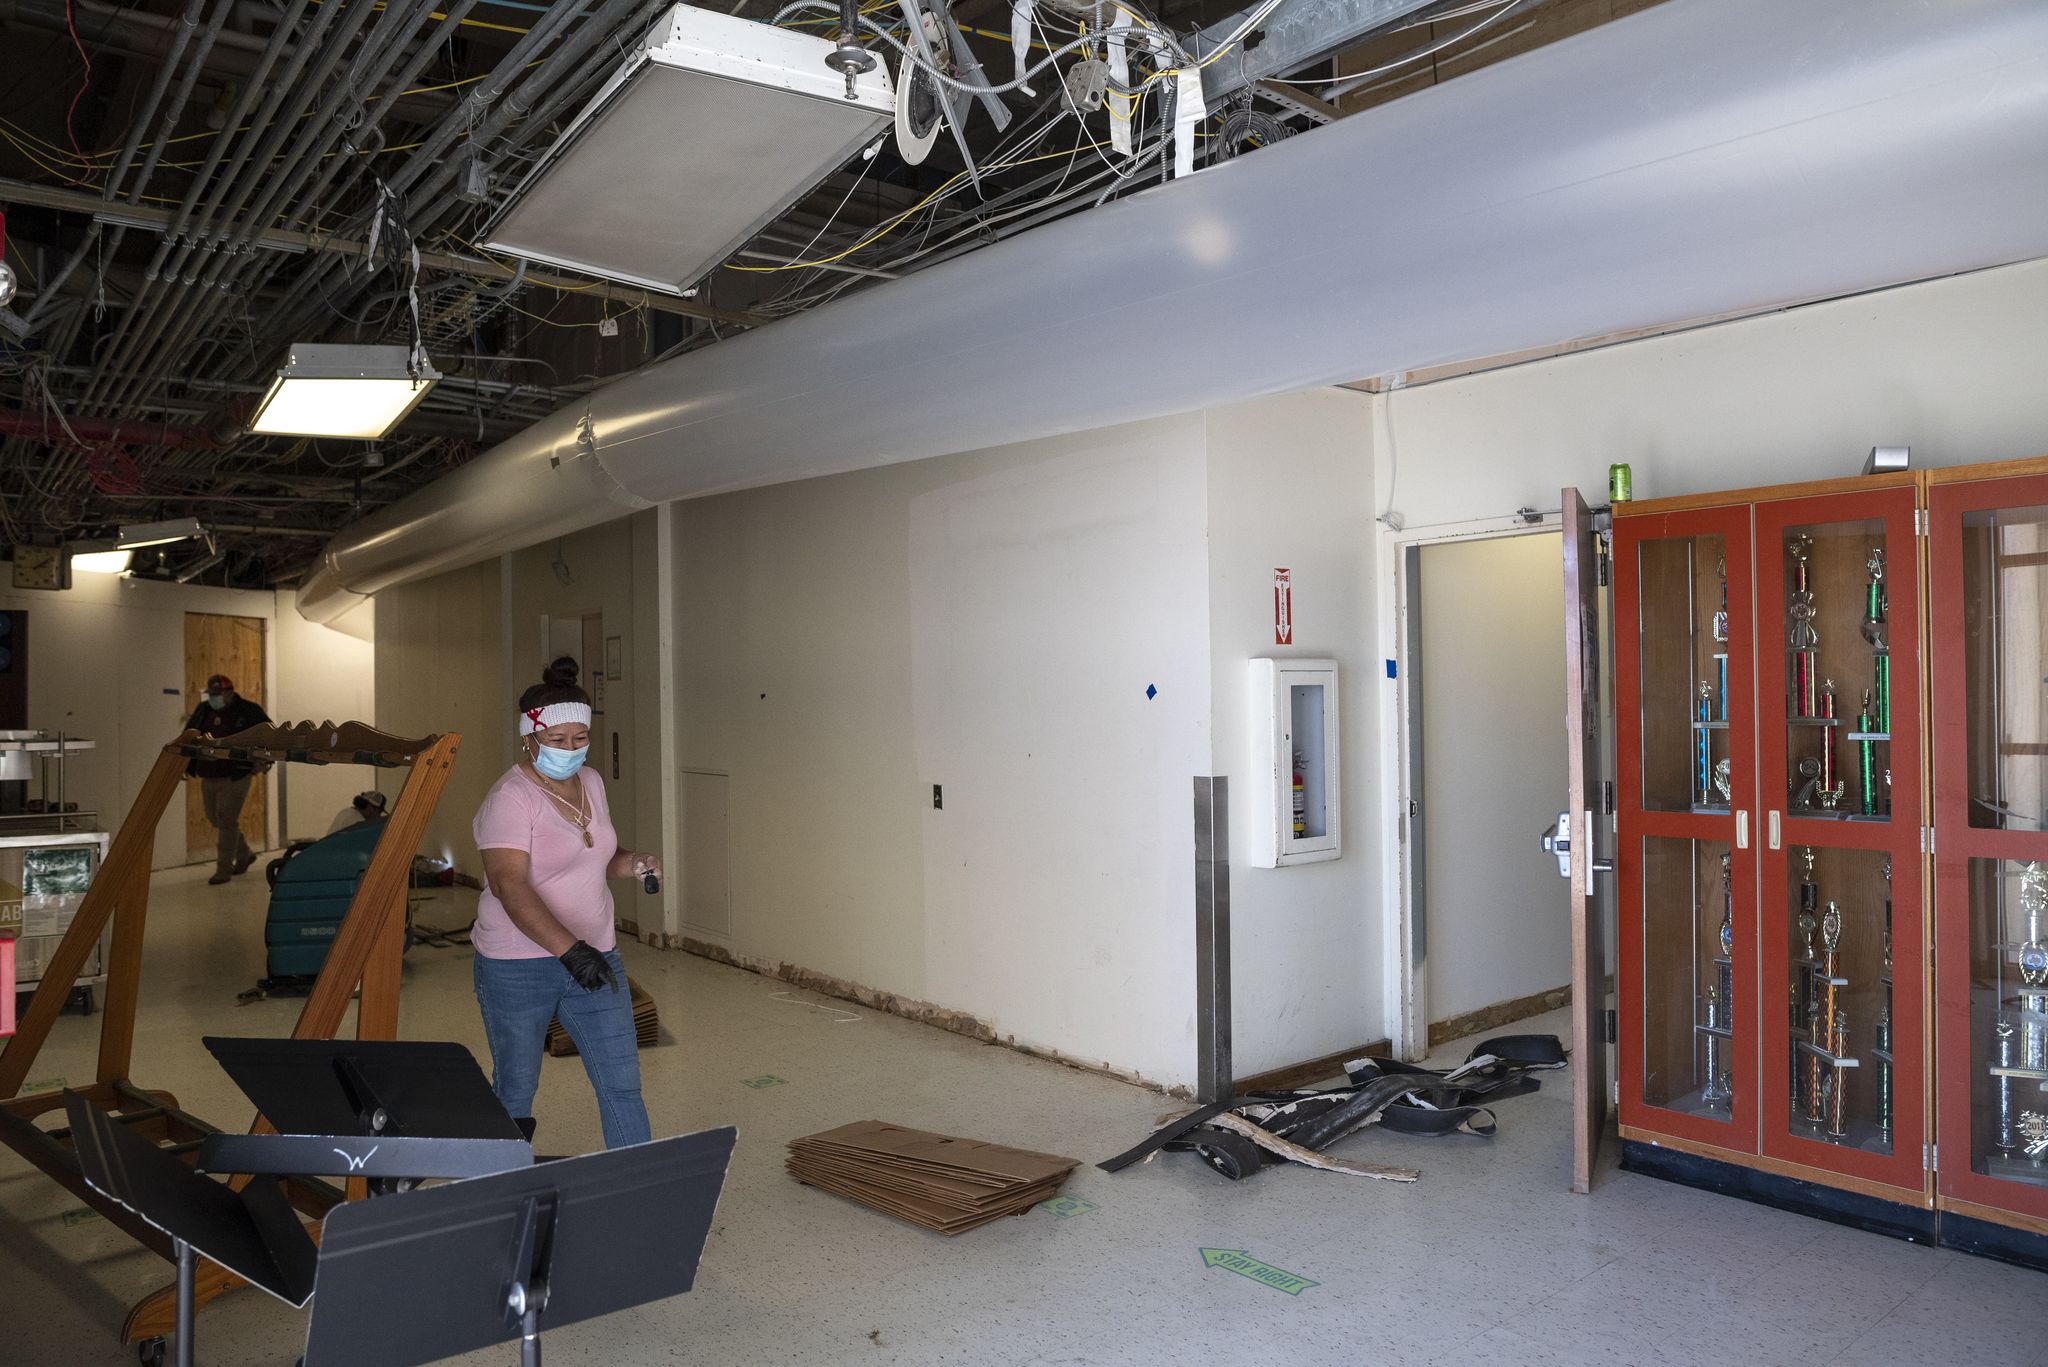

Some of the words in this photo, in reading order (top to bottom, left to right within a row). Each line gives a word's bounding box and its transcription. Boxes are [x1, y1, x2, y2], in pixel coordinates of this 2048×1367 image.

[2027, 1121, 2045, 1131] 2011
[333, 1144, 379, 1172] W
[1214, 1253, 1257, 1270] STAY
[1250, 1267, 1304, 1289] RIGHT
